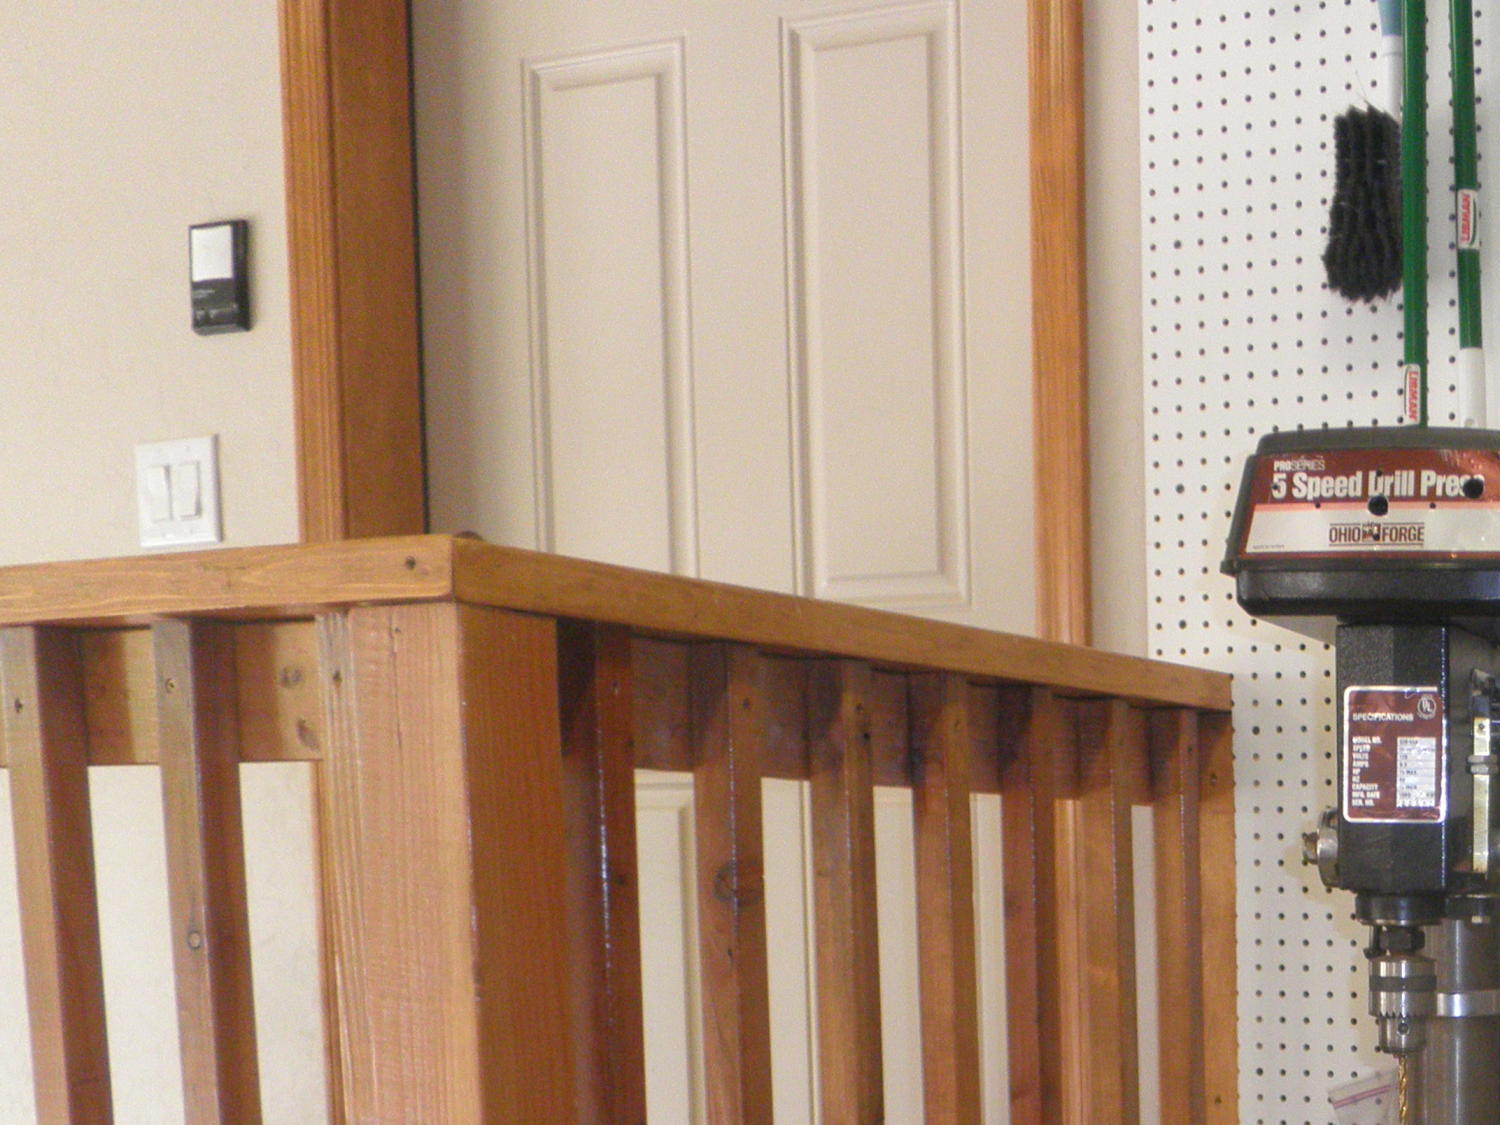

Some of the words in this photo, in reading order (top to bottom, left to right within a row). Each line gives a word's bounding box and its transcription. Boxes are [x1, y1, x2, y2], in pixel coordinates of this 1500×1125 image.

[1272, 472, 1287, 498] 5
[1292, 471, 1363, 500] Speed
[1368, 470, 1415, 497] Drill
[1328, 525, 1362, 544] OHIO
[1381, 525, 1425, 543] FORGE
[1353, 712, 1414, 722] SPECIFICATIONS
